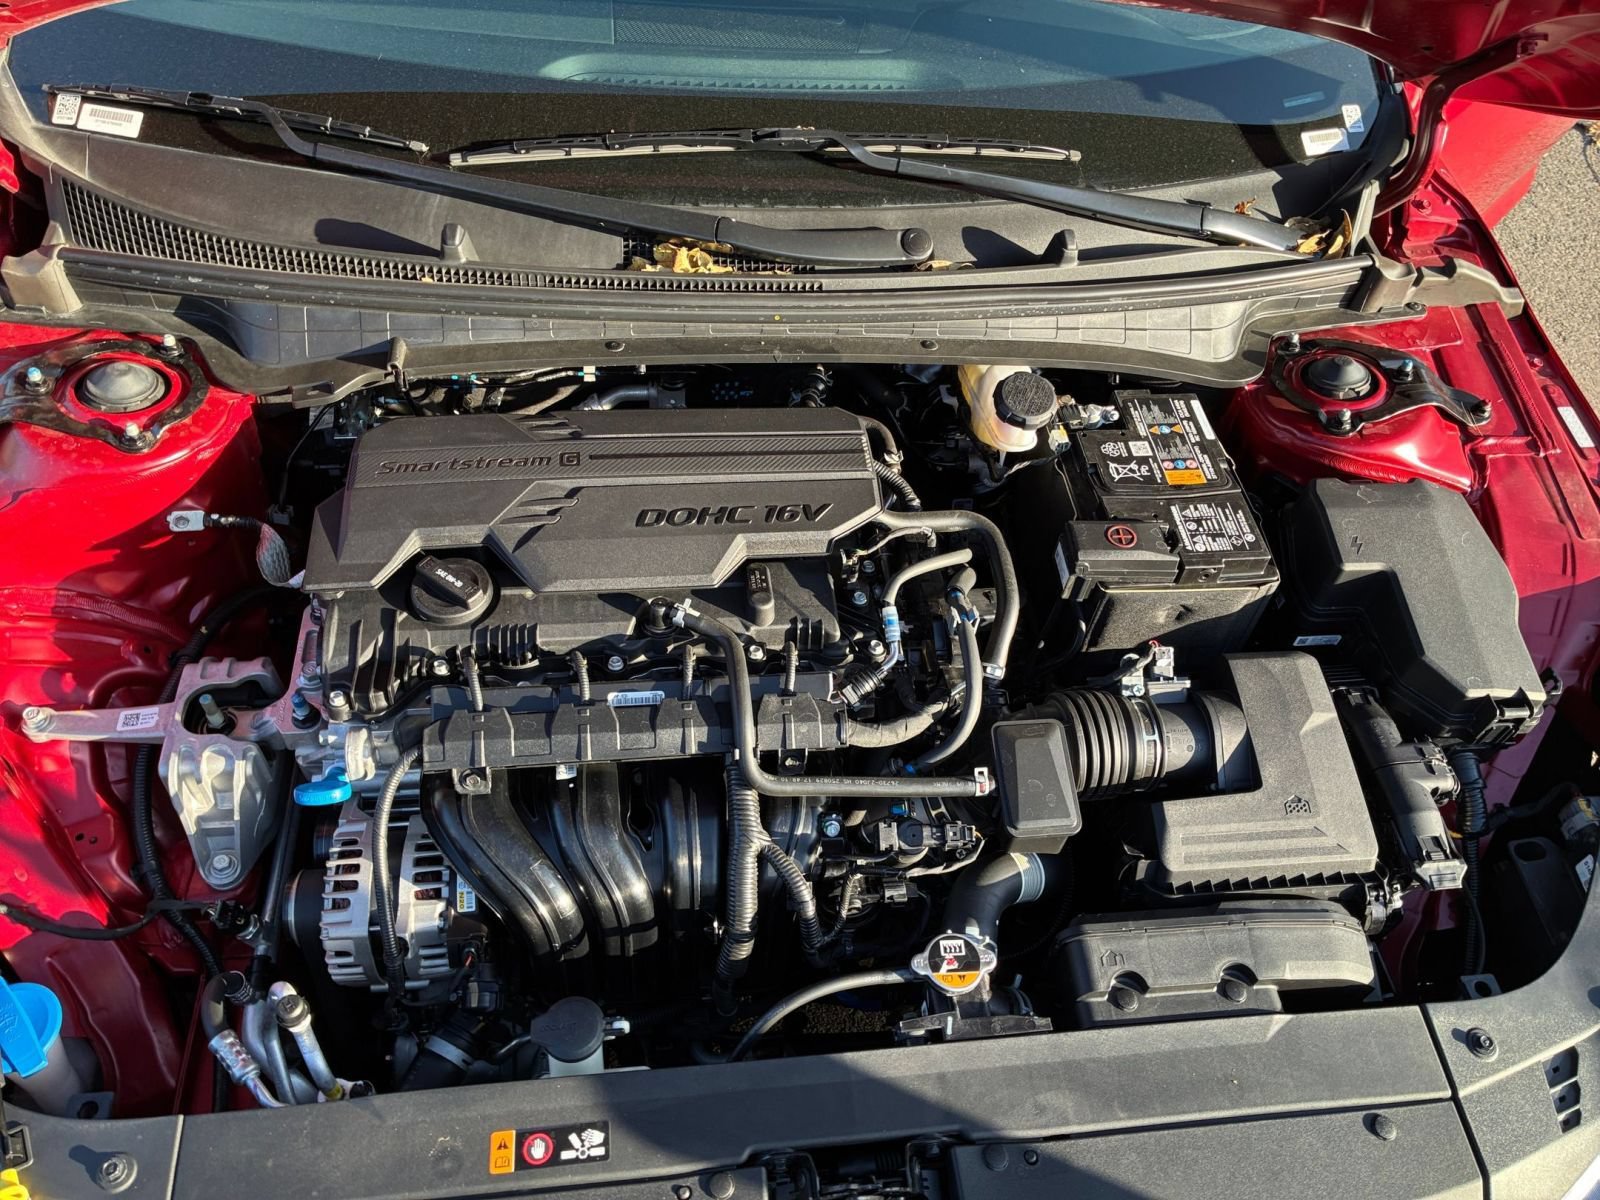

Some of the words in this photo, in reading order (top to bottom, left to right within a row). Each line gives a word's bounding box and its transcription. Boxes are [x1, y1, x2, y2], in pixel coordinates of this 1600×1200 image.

[375, 456, 551, 477] Smartstream
[559, 452, 580, 467] G
[635, 505, 757, 528] DOHC
[764, 503, 834, 523] 16V
[435, 568, 448, 578] SAE
